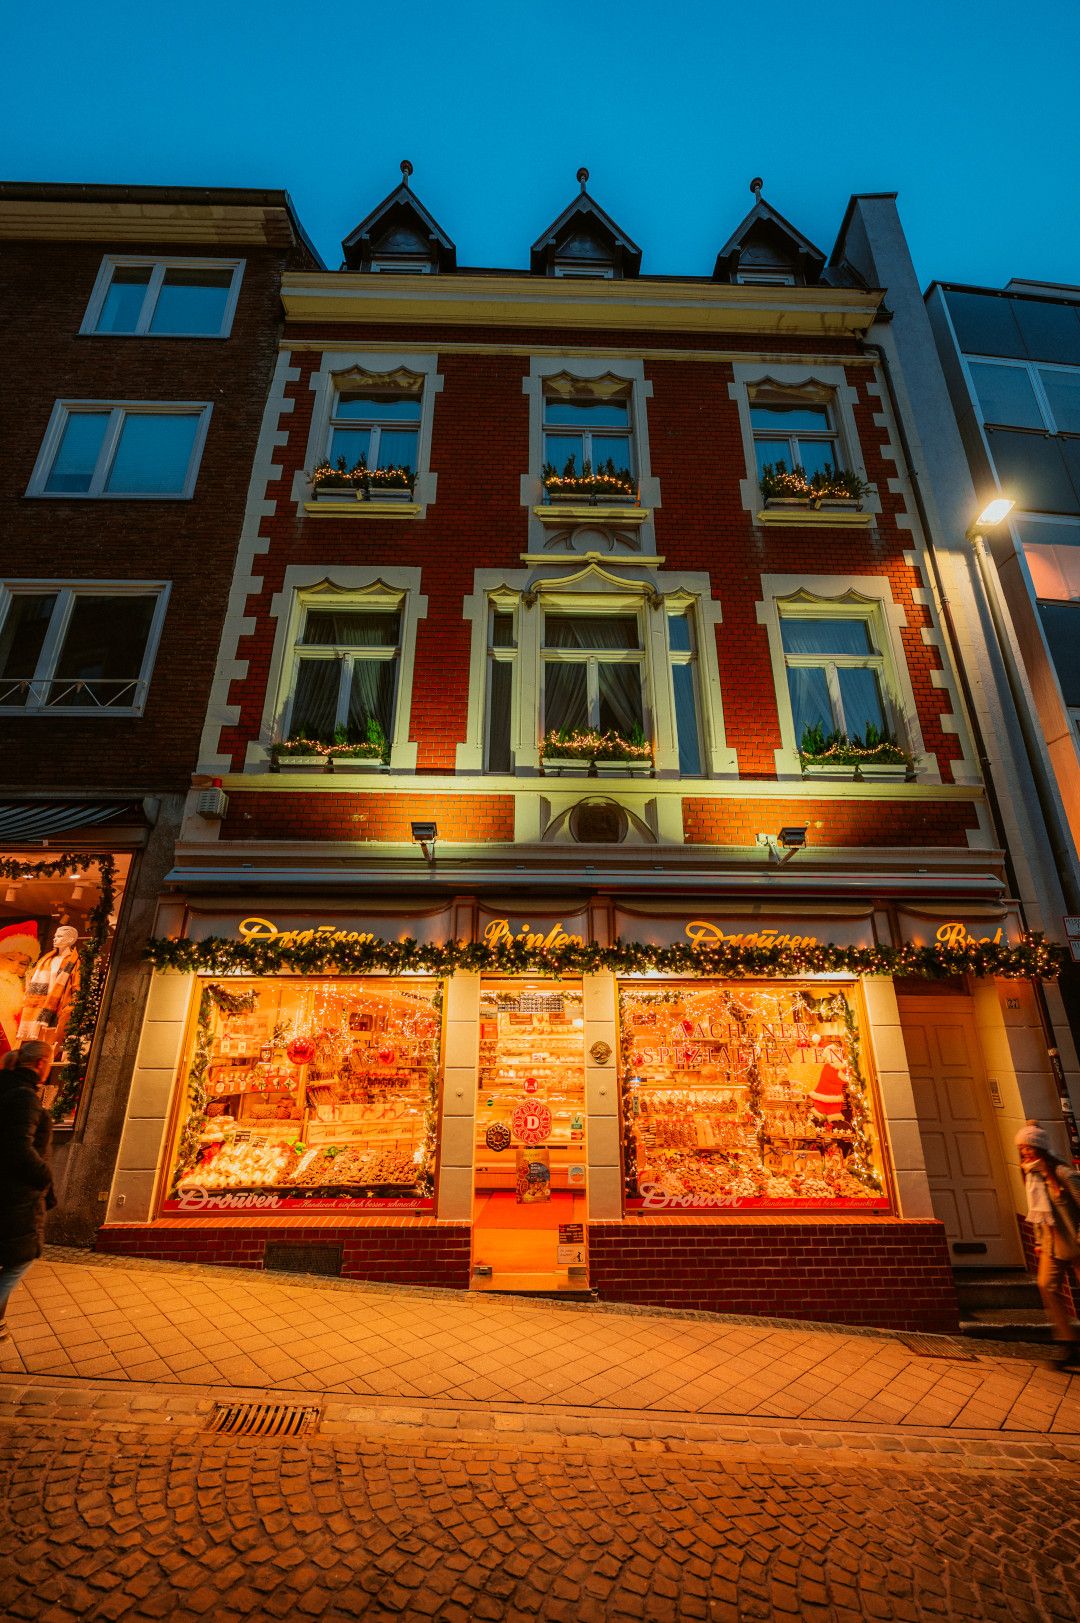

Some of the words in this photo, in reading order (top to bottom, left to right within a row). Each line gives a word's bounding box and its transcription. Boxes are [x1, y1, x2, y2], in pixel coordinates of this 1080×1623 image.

[482, 919, 585, 950] Printen
[675, 1022, 809, 1040] AACHENER
[526, 1116, 540, 1130] D
